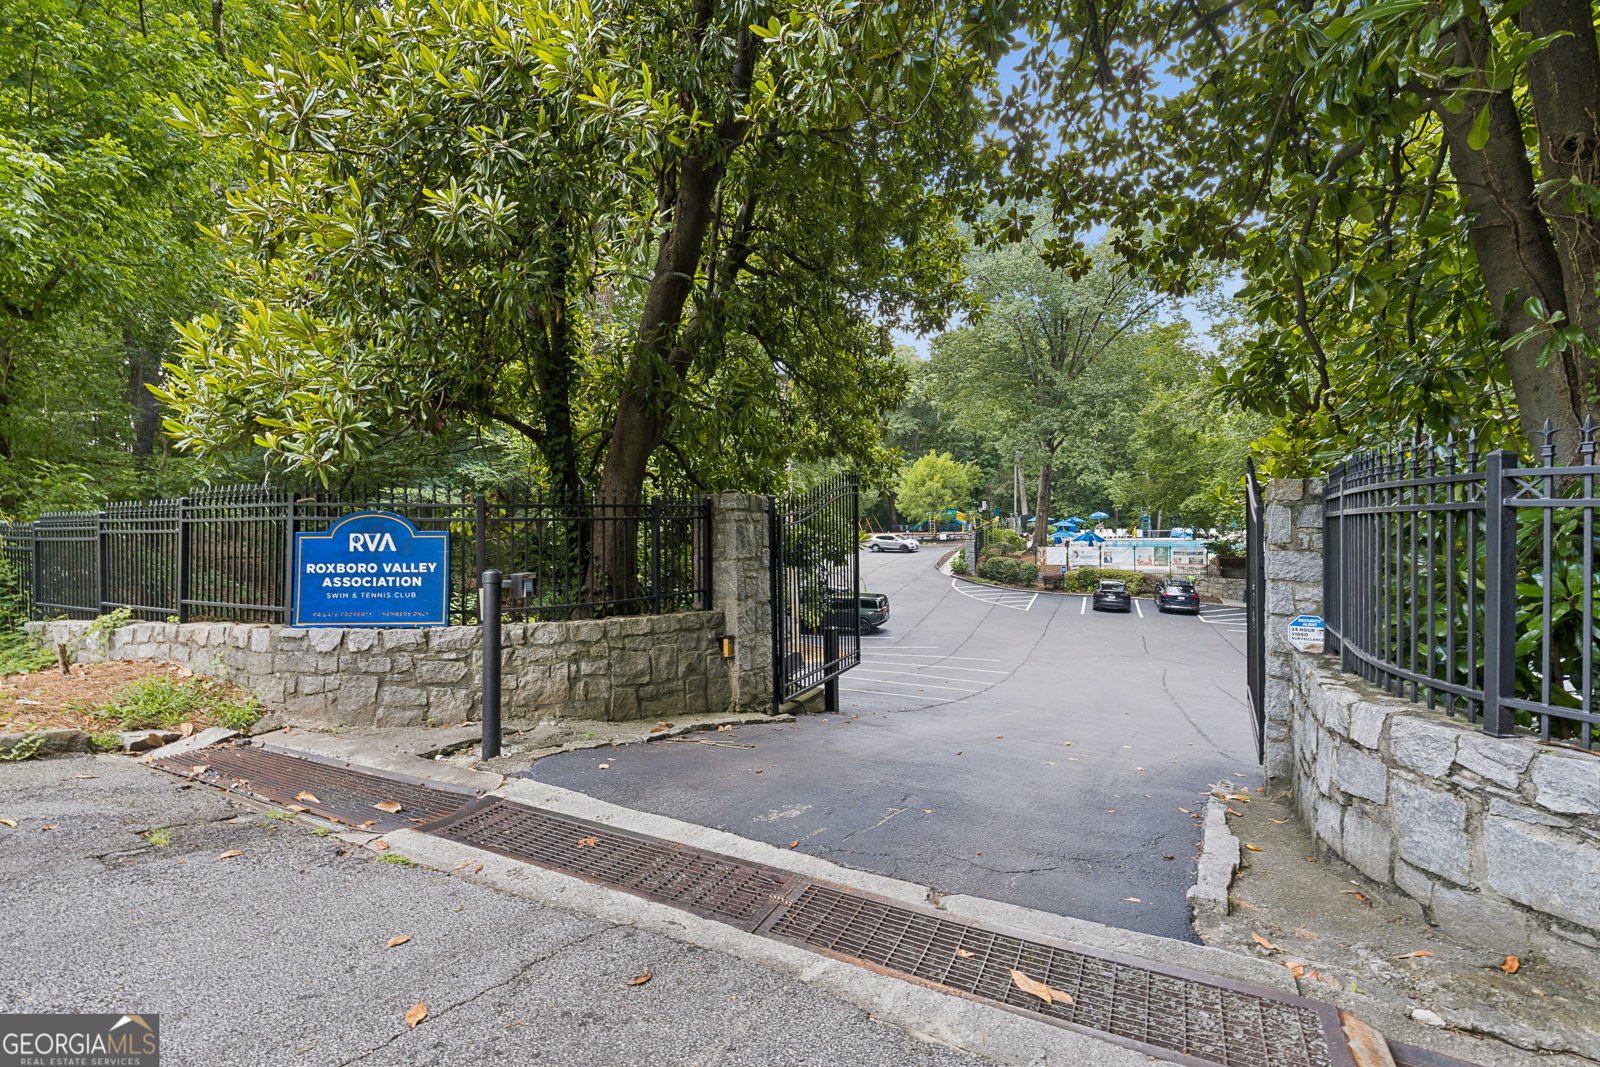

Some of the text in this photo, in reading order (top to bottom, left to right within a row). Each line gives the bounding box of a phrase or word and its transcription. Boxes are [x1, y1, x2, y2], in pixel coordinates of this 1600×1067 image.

[349, 532, 397, 552] RVA
[306, 562, 437, 574] ROXBORO VALLEY
[322, 576, 422, 588] ASSOCIATION
[394, 591, 417, 599] CLUB
